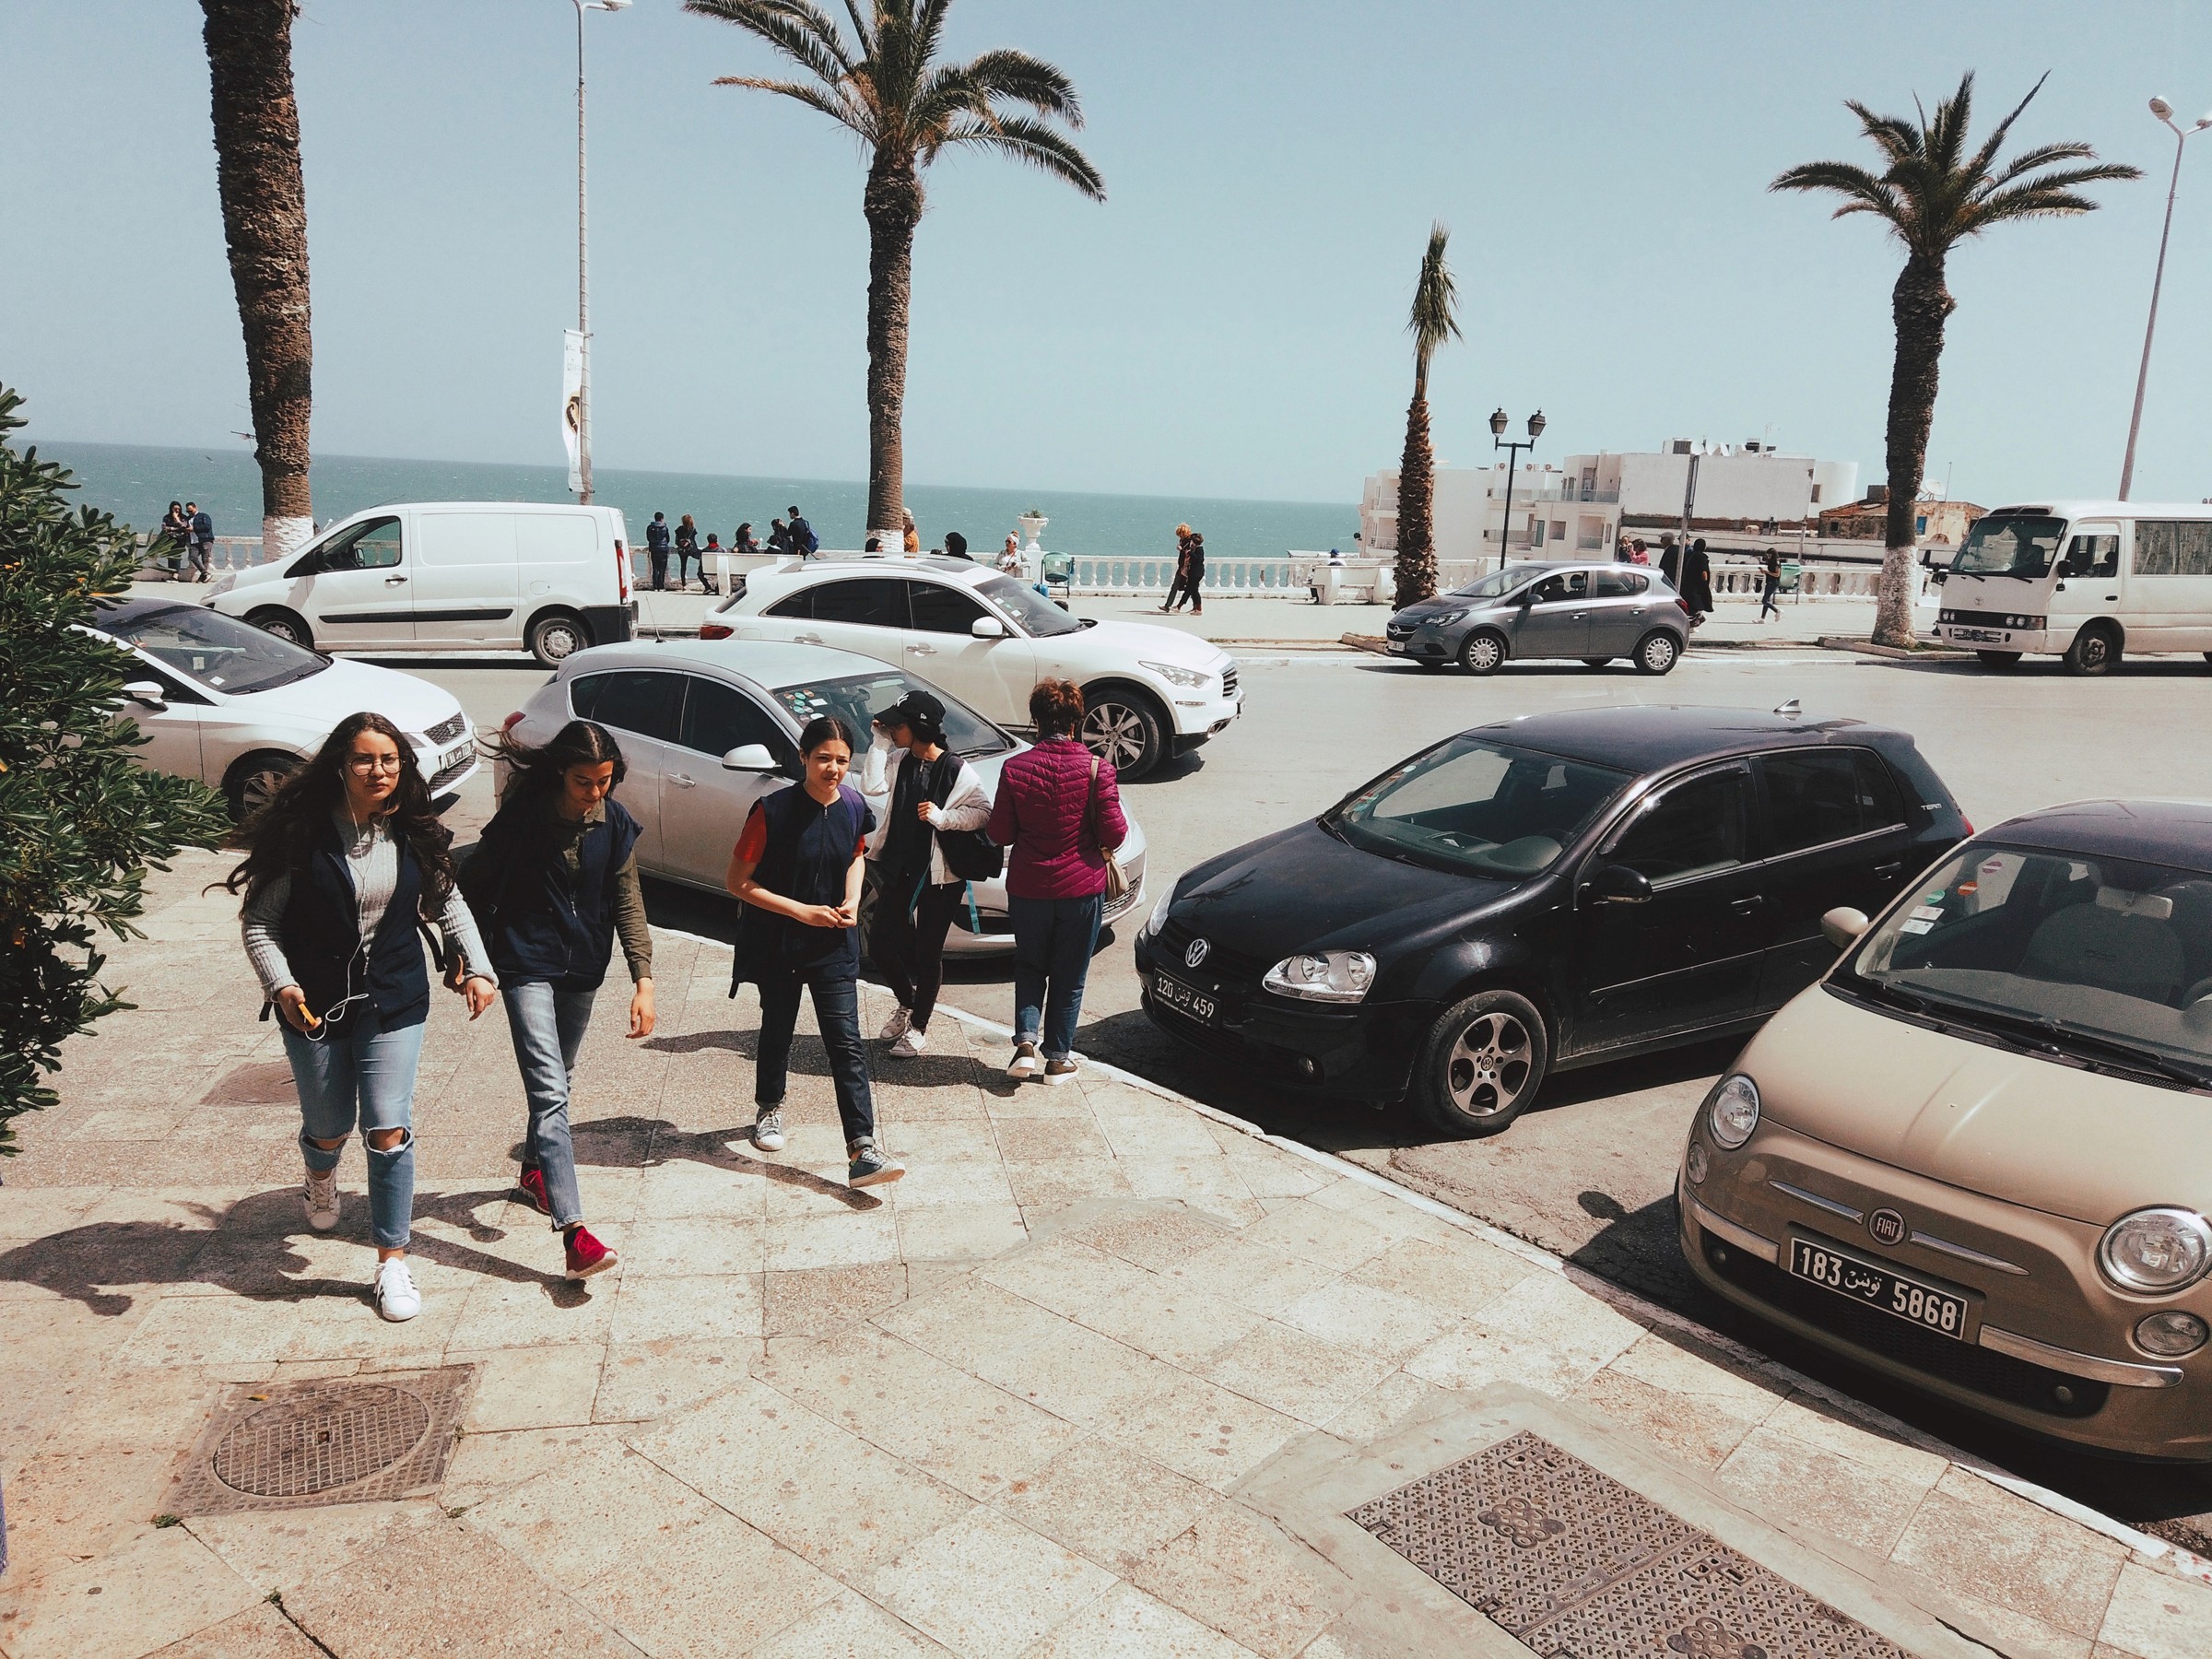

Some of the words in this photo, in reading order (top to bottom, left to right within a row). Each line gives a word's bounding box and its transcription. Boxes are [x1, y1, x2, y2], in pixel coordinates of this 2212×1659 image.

[1157, 976, 1173, 998] 120
[1193, 996, 1215, 1018] 459
[1876, 1217, 1899, 1237] FIAT
[1801, 1247, 1842, 1286] 183
[1844, 1270, 1882, 1298] تونس
[1892, 1281, 1957, 1331] 5868
